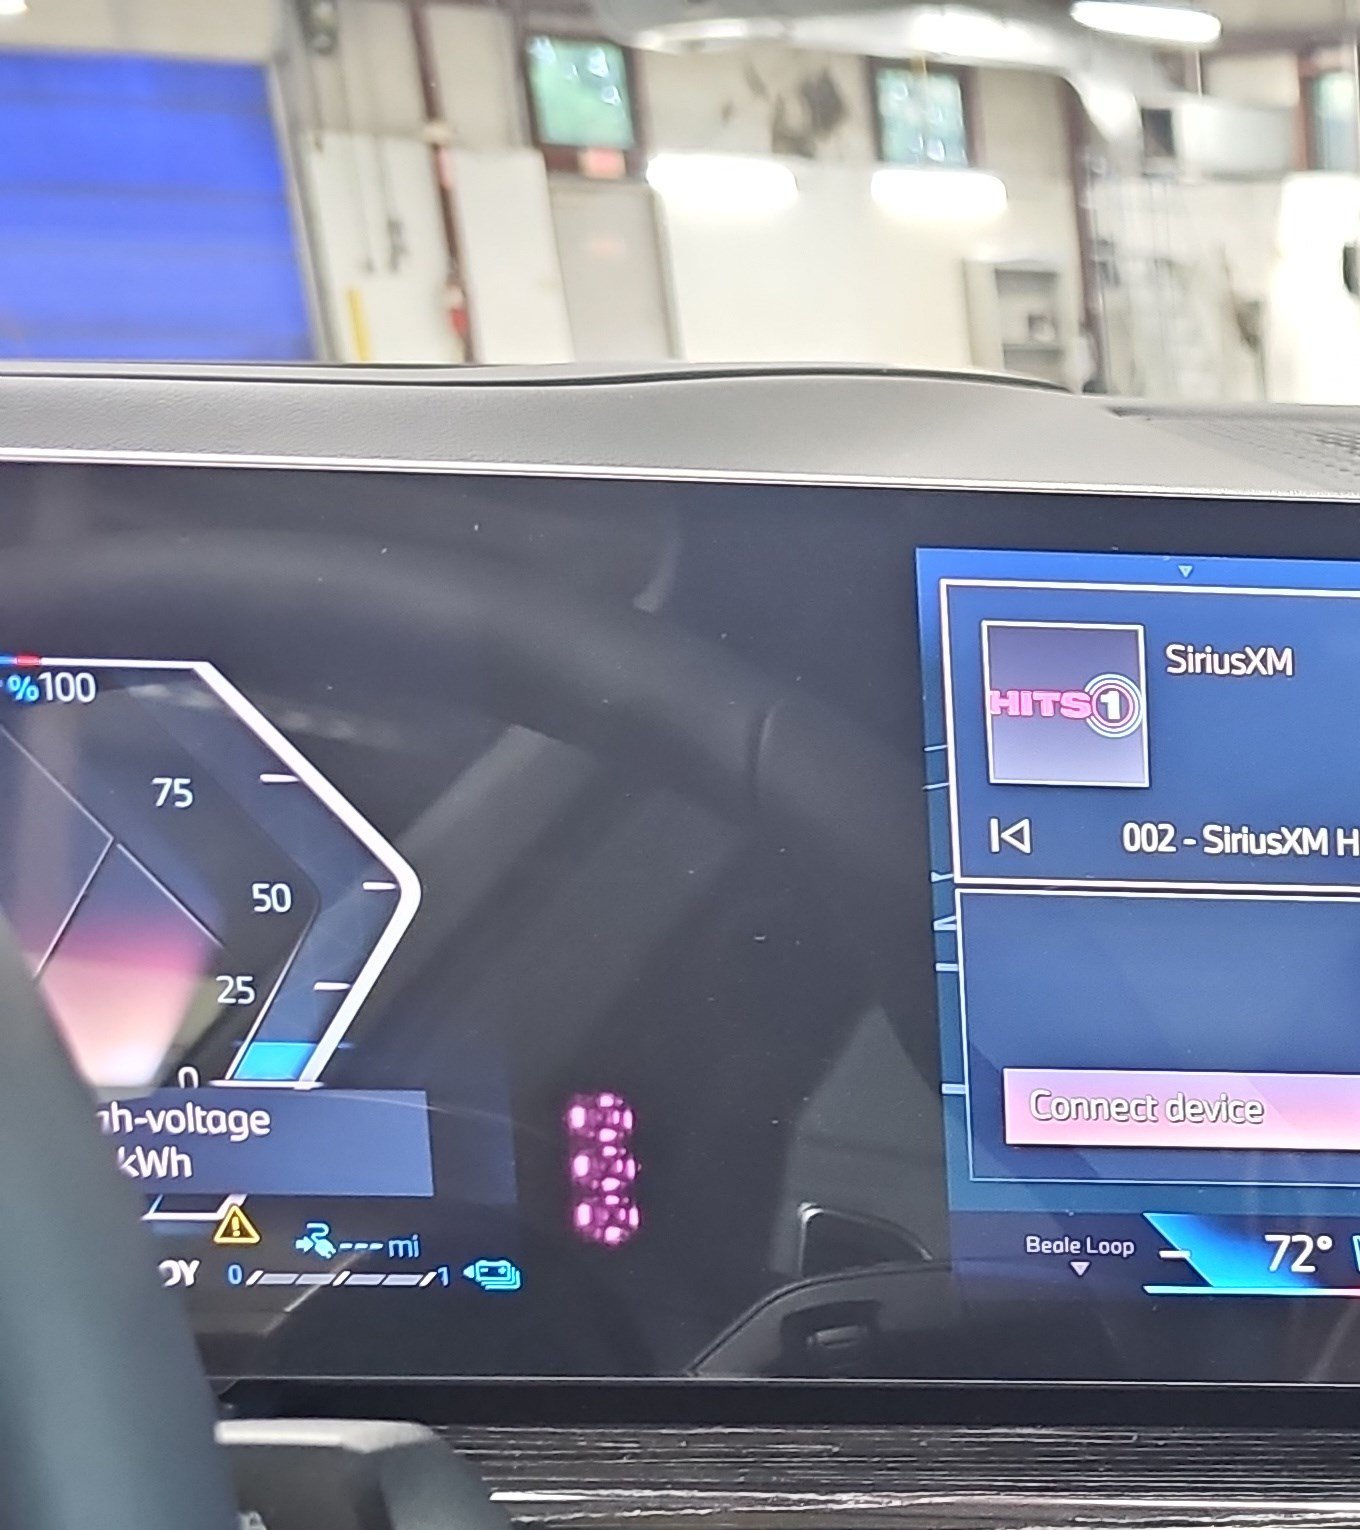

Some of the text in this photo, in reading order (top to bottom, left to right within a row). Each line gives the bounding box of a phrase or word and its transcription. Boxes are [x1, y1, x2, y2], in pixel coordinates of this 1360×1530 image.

[1166, 643, 1294, 677] SiriusXM
[38, 671, 96, 702] 100
[990, 690, 1121, 720] HITS 1
[152, 778, 193, 808] 75
[1123, 824, 1176, 853] 002
[1203, 826, 1329, 858] SiriusXM
[252, 883, 291, 913] 50
[217, 976, 256, 1005] 25
[1029, 1089, 1264, 1127] Connect device
[118, 1145, 192, 1178] kWh
[388, 1234, 420, 1258] mi
[1026, 1235, 1135, 1258] Beale Loop
[1264, 1234, 1333, 1273] 72°
[227, 1263, 243, 1286] 0
